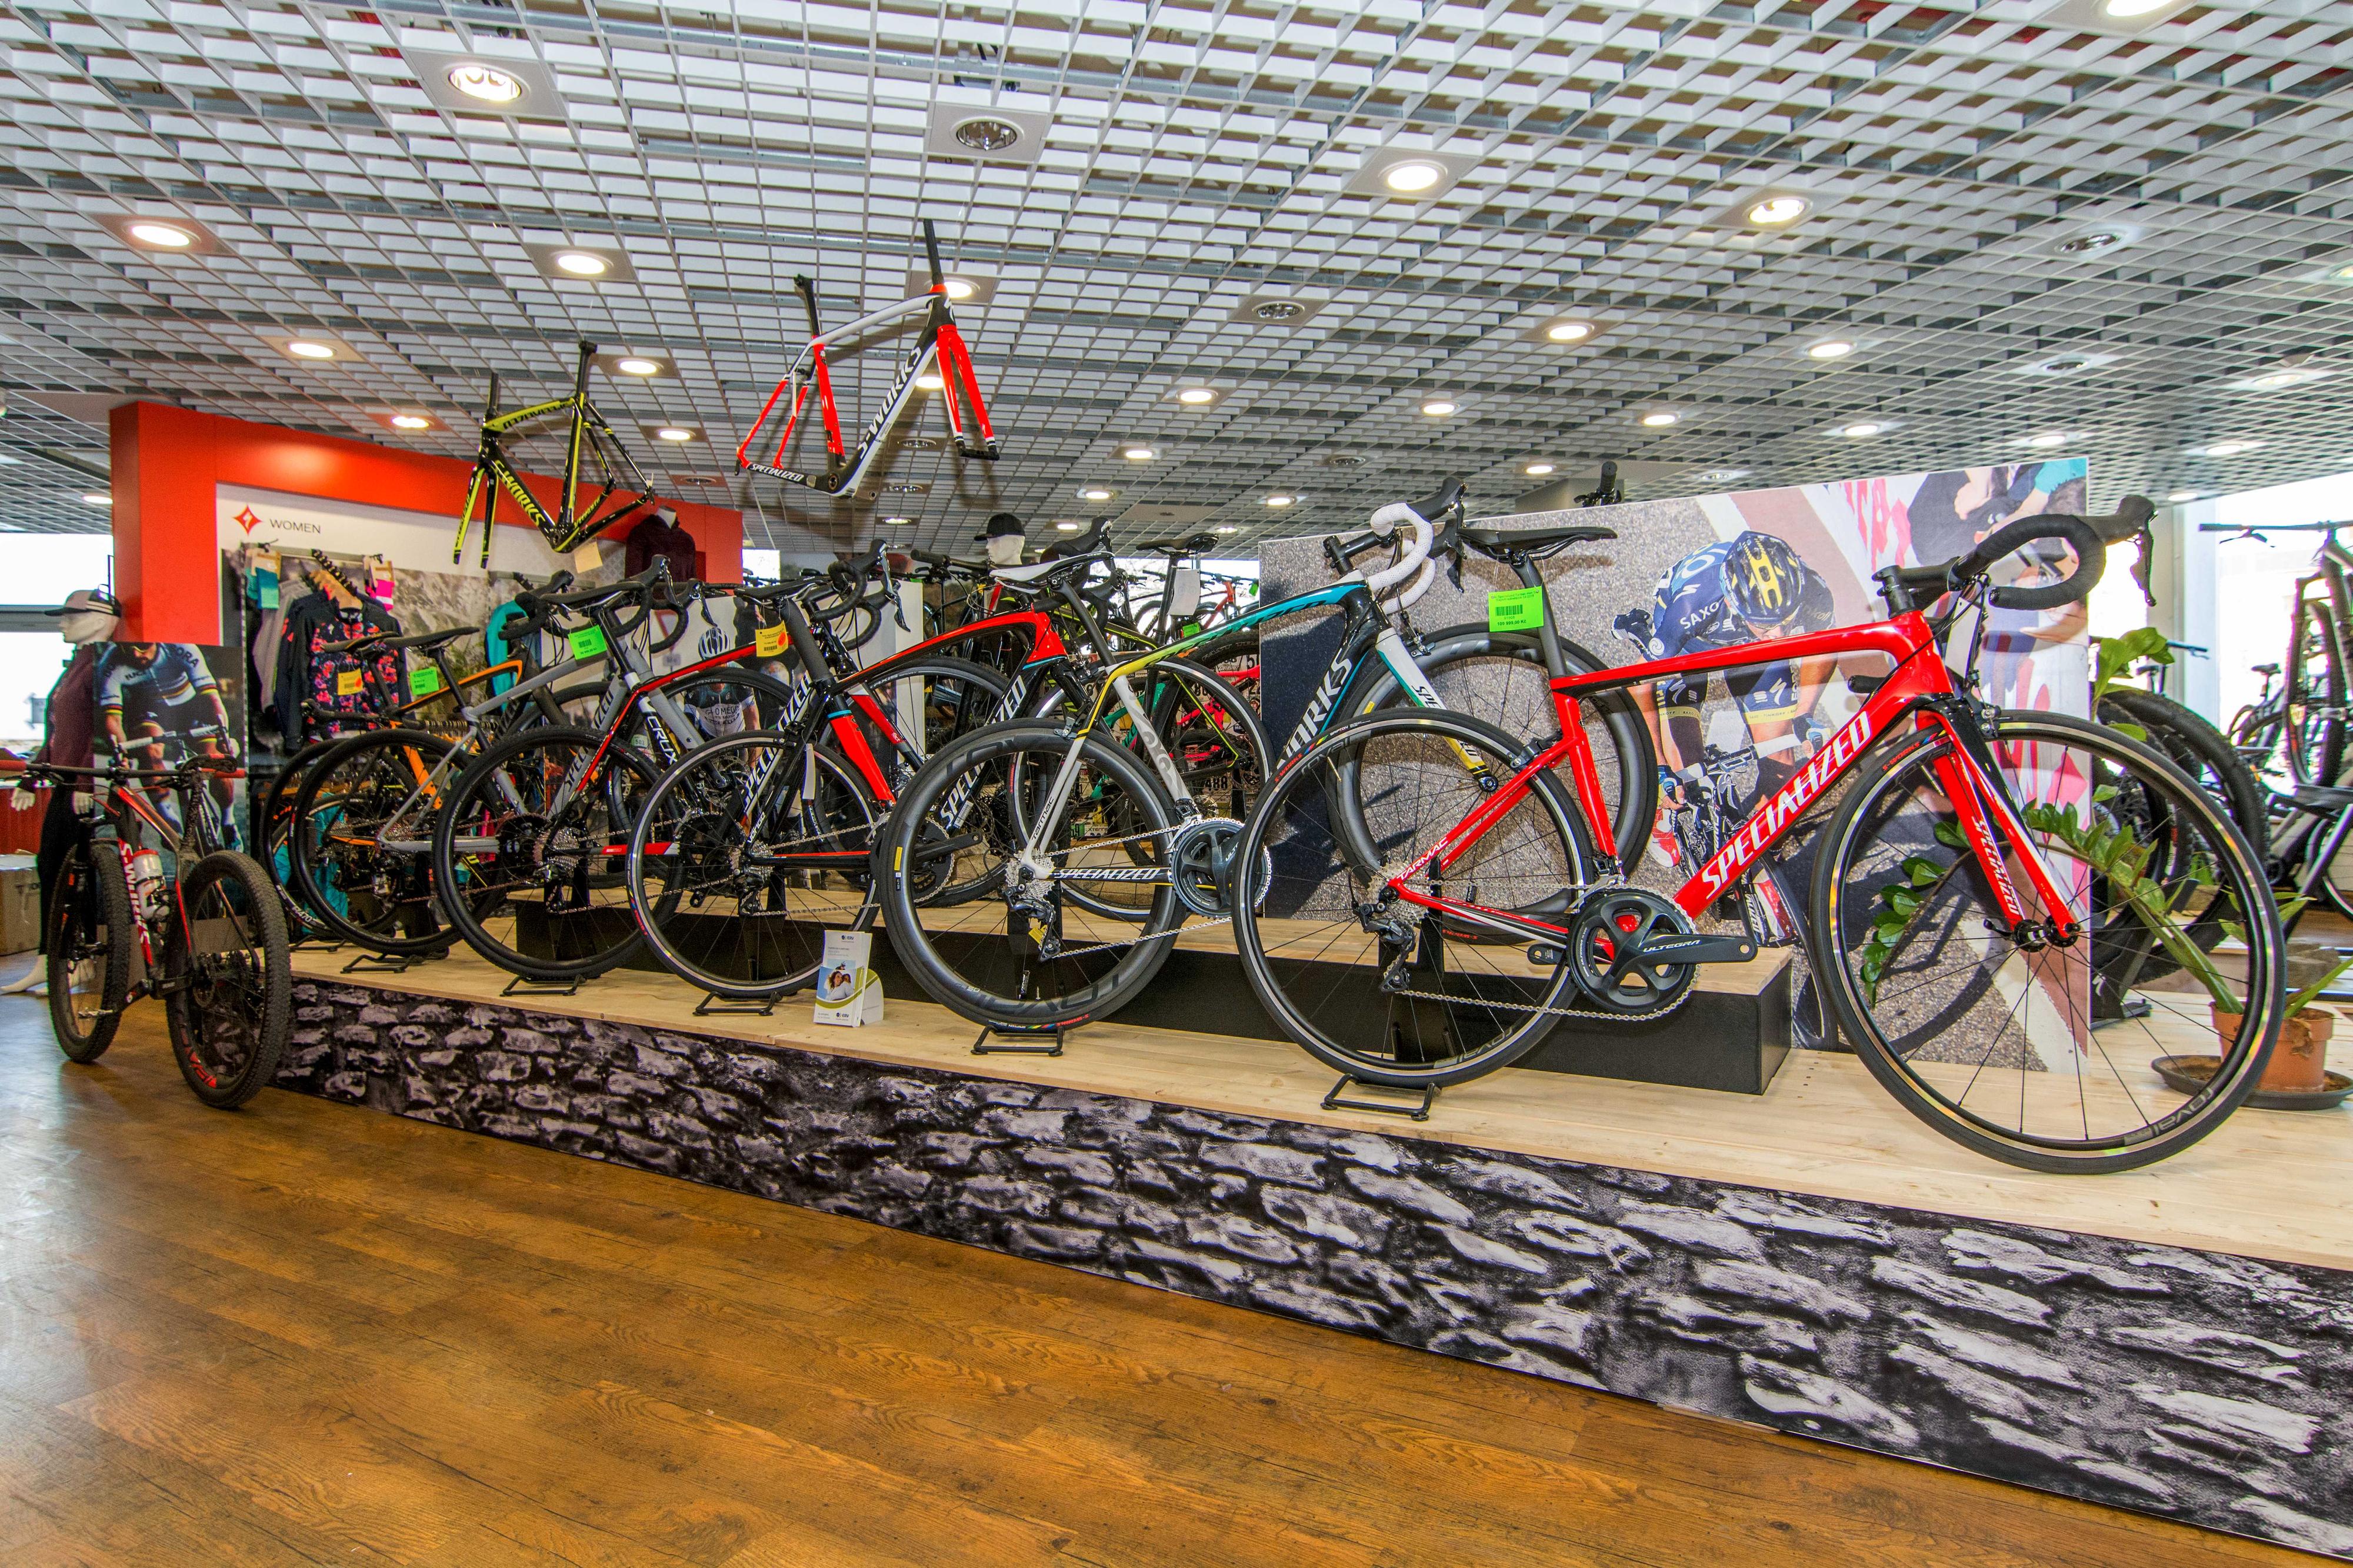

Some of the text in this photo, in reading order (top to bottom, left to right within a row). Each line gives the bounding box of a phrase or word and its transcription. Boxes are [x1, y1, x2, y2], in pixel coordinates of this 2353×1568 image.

[751, 463, 804, 482] SPECIALIZED
[269, 519, 321, 533] WOMEN
[1679, 601, 1720, 630] SAXO
[647, 716, 678, 765] CRUX
[1275, 753, 1303, 783] S-WORKS
[1883, 742, 1920, 771] S-WORKS
[1702, 710, 1872, 900] SPECIALIZED
[1397, 837, 1449, 880] TARMAC
[1971, 815, 2020, 916] SPECIALIZED
[1055, 868, 1162, 880] SPECIALIZED
[1643, 939, 1701, 953] ULTEGRA
